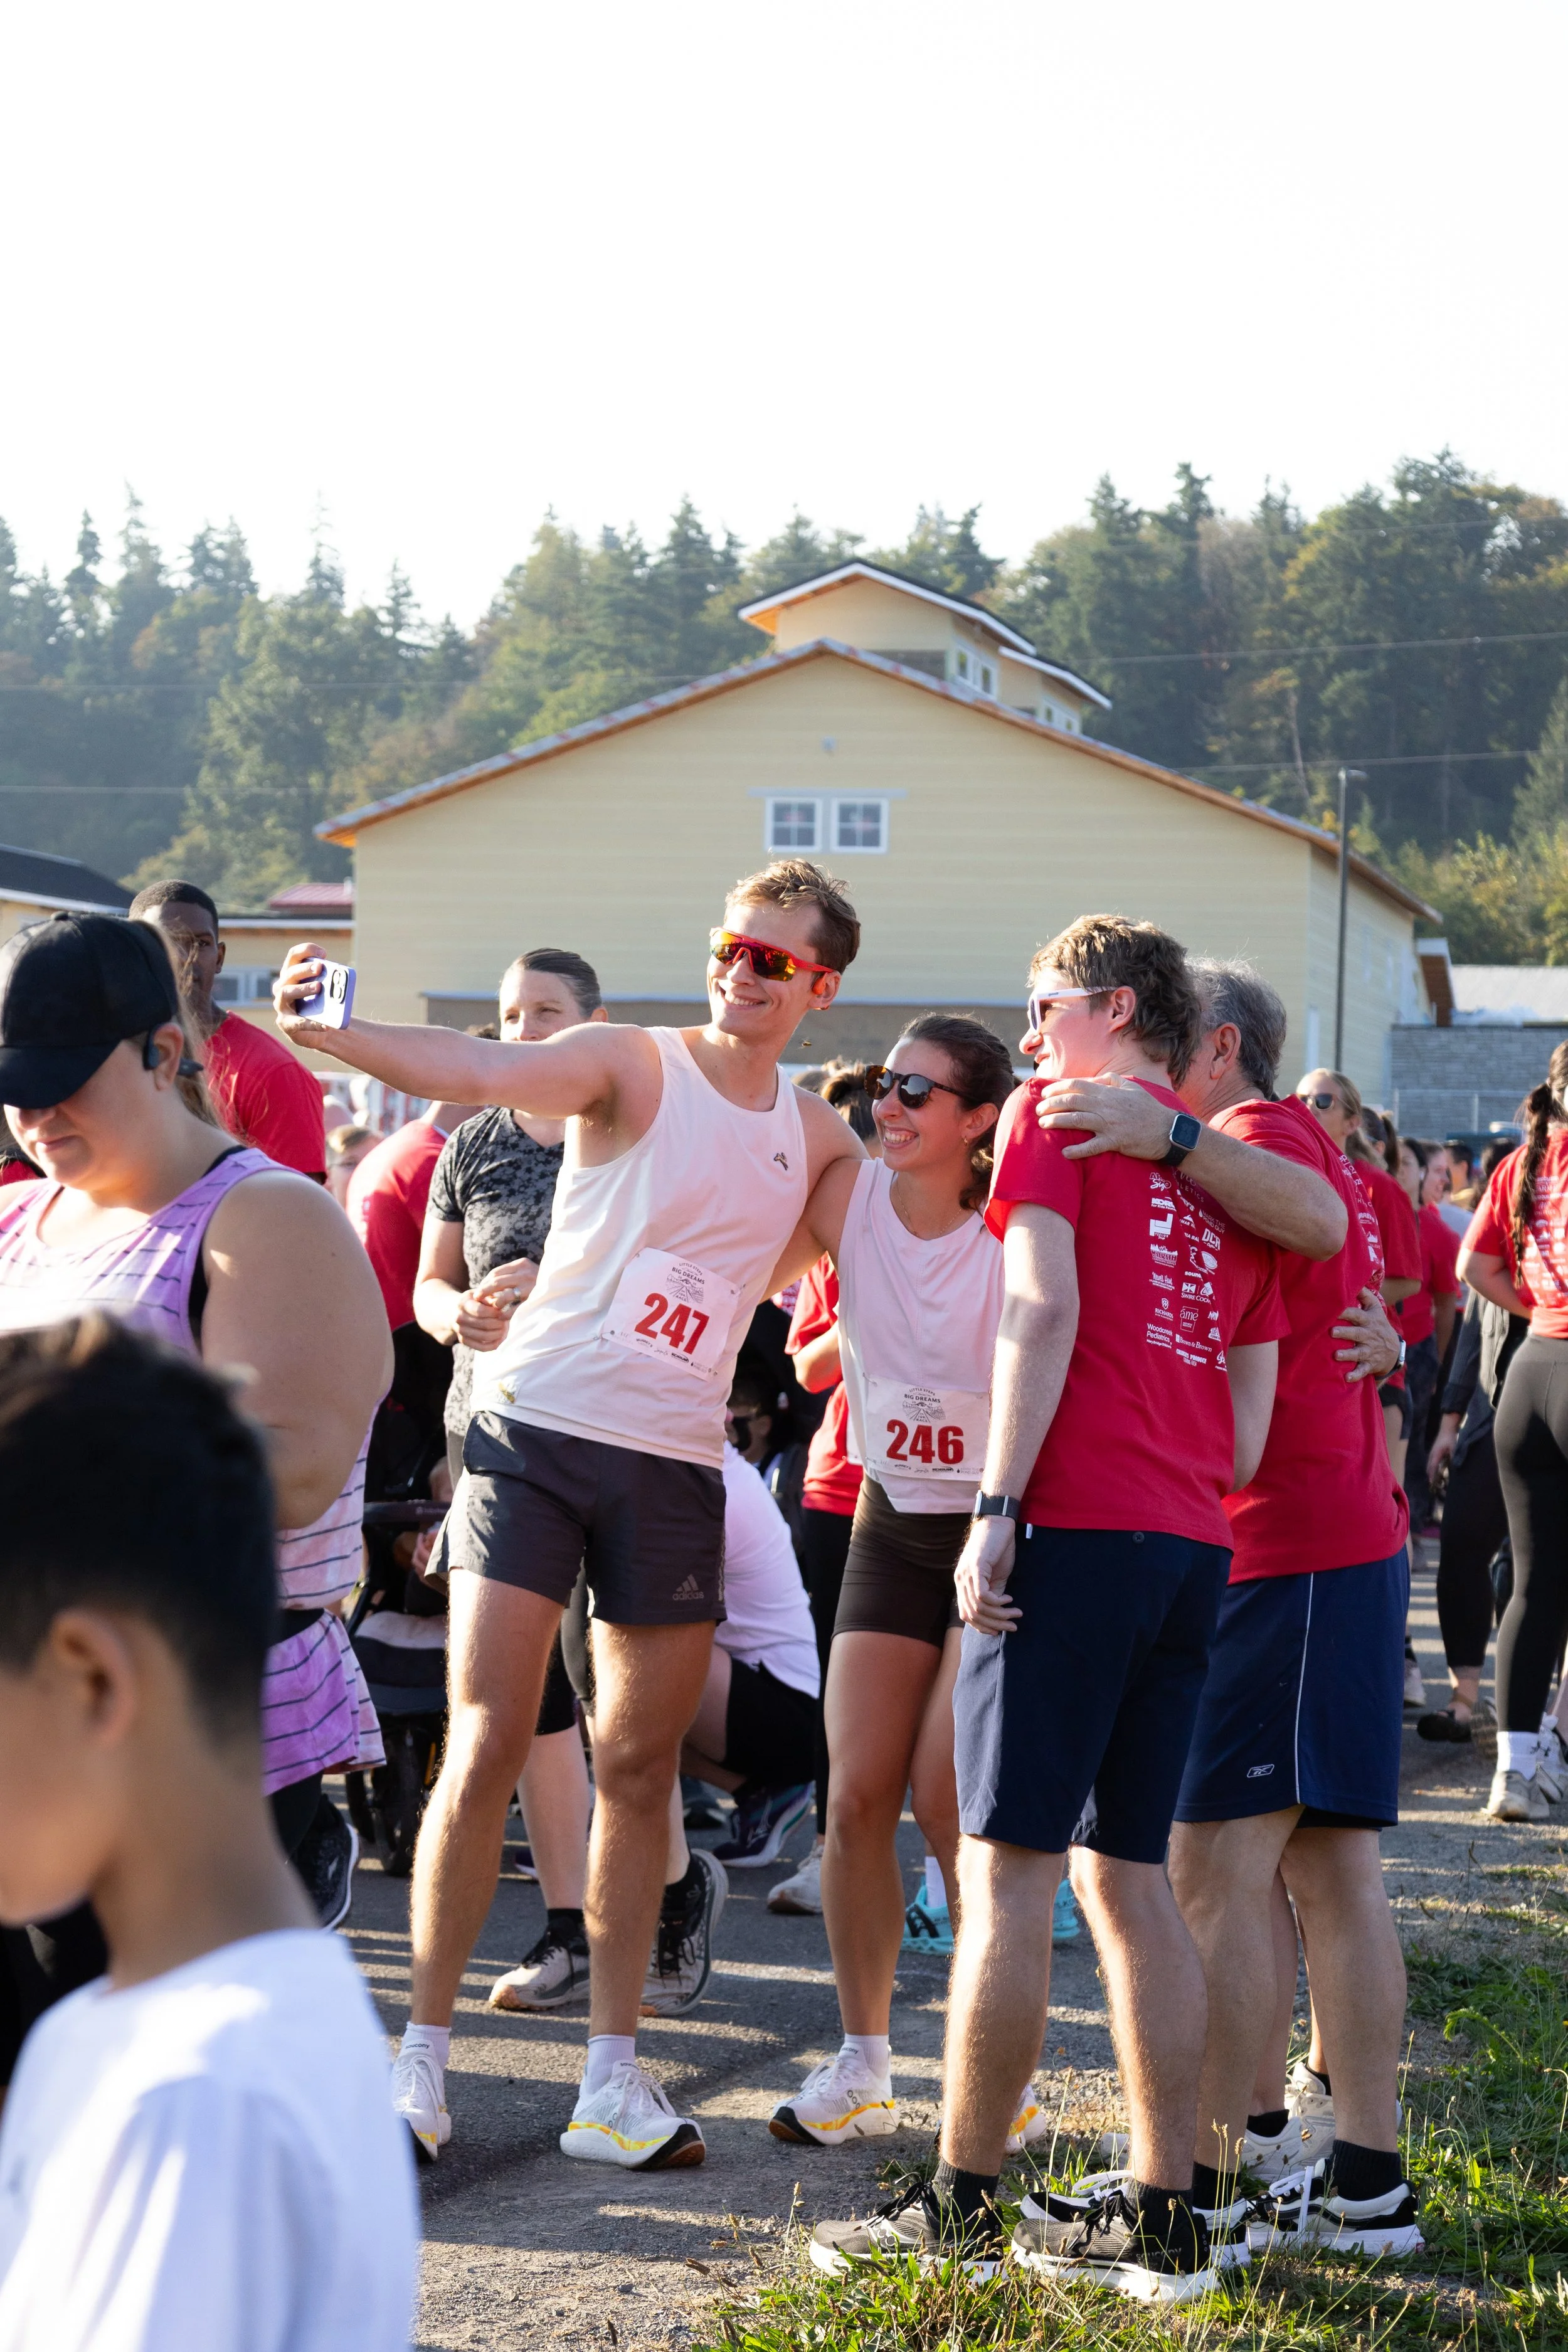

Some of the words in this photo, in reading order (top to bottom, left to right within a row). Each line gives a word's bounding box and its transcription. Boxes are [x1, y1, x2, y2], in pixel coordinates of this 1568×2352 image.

[1214, 1225, 1226, 1234] GUY
[1216, 1219, 1226, 1228] THE
[672, 1266, 682, 1274] BIG
[682, 1271, 706, 1285] DREAMS
[1155, 1308, 1173, 1319] RICHARDS
[634, 1292, 711, 1355] 247
[1147, 1323, 1173, 1337] Woodcreek
[1147, 1330, 1170, 1343] Pediatrics
[1179, 1336, 1192, 1347] Brown
[1195, 1341, 1212, 1352] Brown
[923, 1388, 936, 1396] STEPS
[915, 1396, 941, 1404] DREAMS
[886, 1419, 964, 1465] 246
[672, 1591, 704, 1601] adidas
